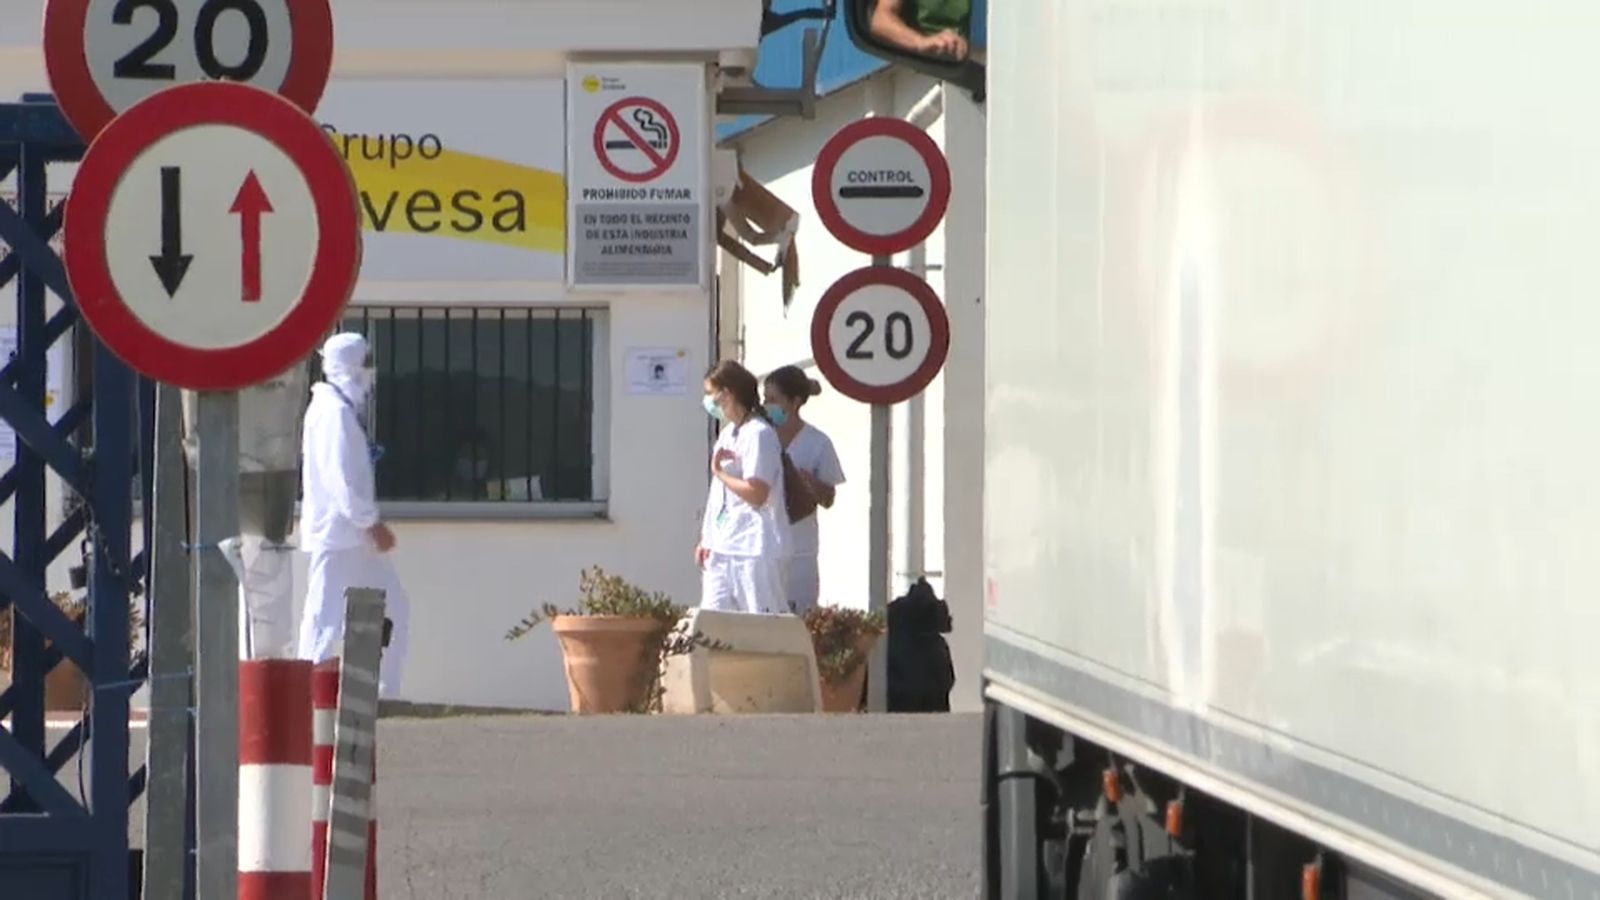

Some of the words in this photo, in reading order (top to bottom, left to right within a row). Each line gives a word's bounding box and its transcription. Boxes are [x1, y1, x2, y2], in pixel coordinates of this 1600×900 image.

[112, 0, 269, 80] 20
[847, 170, 914, 184] CONTROL
[583, 188, 647, 200] PROHIBIDO
[649, 188, 691, 200] FUMAR
[584, 214, 598, 225] EN
[600, 214, 628, 225] TODO
[631, 214, 642, 225] EL
[645, 213, 691, 225] RECINTO
[586, 229, 600, 240] DE
[602, 229, 629, 240] ESTA
[631, 229, 688, 240] INDUSTRIA
[845, 311, 913, 360] 20
